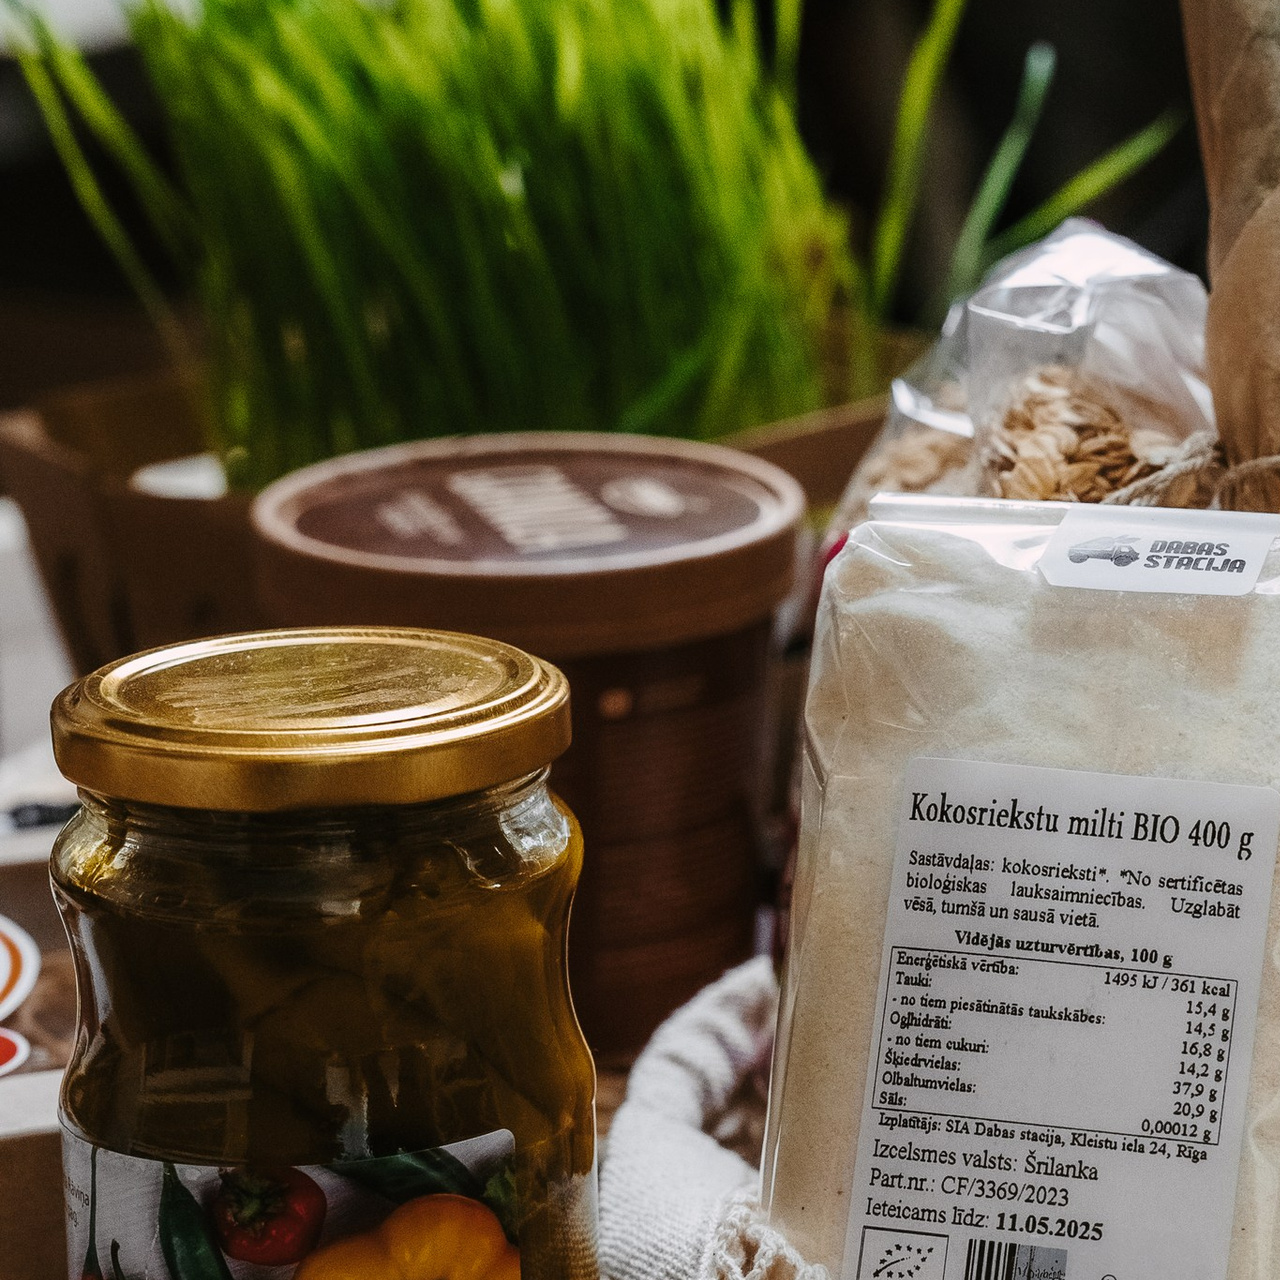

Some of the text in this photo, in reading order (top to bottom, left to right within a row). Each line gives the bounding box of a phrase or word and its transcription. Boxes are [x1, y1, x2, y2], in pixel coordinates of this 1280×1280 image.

[1143, 554, 1247, 574] STACIJA
[1149, 539, 1231, 557] DABAS
[908, 791, 1255, 862] Kokosriekstu milti BIO 400 g
[906, 871, 1241, 920] bioloģiskas lauksaimniecības. Uzglabāt
[908, 849, 995, 875] Sastāvdaļas:
[1157, 874, 1244, 897] sertificētas
[903, 895, 1100, 929] vēsā, tumšā un sausā vietā.
[954, 929, 1174, 969] Vidējās uzturvērtības, 100 g
[895, 970, 1231, 1022] Tauki: 15,4 g
[896, 950, 1231, 998] Enerģētiskā vērtība: 1495 kJ / 361 kcal
[889, 1010, 1226, 1063] Ogļhidrāti: 16,8 g
[900, 995, 916, 1006] no
[919, 992, 947, 1010] tiem
[949, 996, 1025, 1017] piesātinātās
[1028, 1005, 1106, 1025] taukskābes:
[1185, 1020, 1216, 1039] 14,5
[1220, 1028, 1230, 1043] g
[883, 1046, 1218, 1103] Šķiedrvielas: 37,9 g
[894, 1035, 911, 1047] no
[914, 1035, 942, 1050] tiem
[945, 1037, 990, 1054] cukuri:
[1178, 1060, 1210, 1079] 14,2
[1213, 1068, 1223, 1083] g
[878, 1090, 1212, 1143] Sāls: 0,00012 g
[881, 1070, 1219, 1124] Olbaltumvielas: 20,9 g
[872, 1138, 1099, 1181] Izcelsmes valsts: Šrilanka
[878, 1111, 1208, 1163] Izplatītājs: SIA Dabas stacija, Kleistu iela 24, Rīga
[868, 1167, 1069, 1207] Part.nr.: CF/3369/2023
[865, 1196, 1104, 1242] Ieteicams līdz: 11.05.2025
